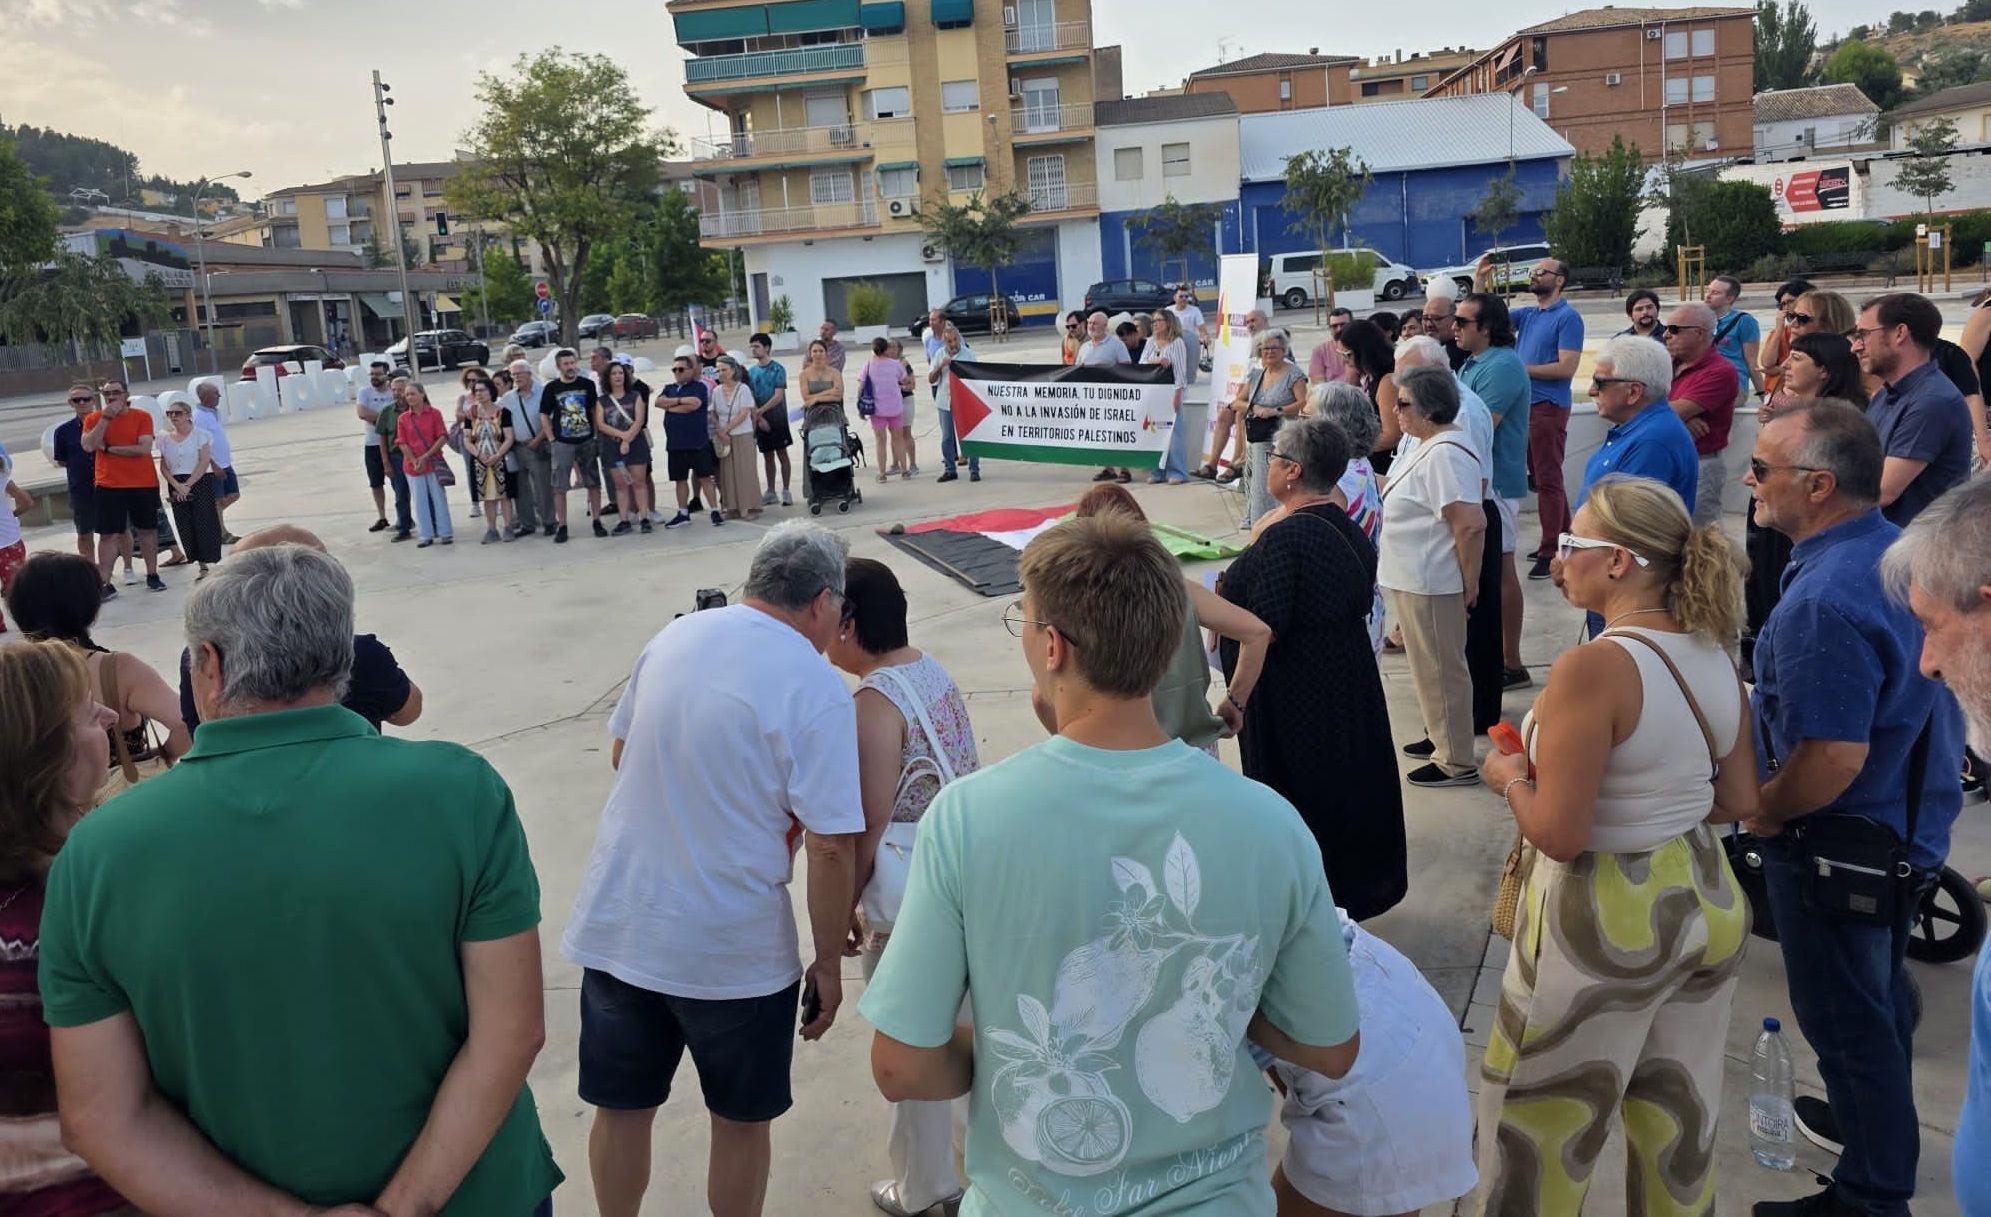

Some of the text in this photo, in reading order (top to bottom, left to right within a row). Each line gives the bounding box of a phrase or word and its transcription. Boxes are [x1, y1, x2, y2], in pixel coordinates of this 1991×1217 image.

[1195, 279, 1214, 287] CAR
[1027, 293, 1045, 302] CAR
[988, 385, 1141, 400] NUESTRA MEMORIA, TU DIGNIDAD
[1001, 404, 1136, 422] NO A LA INVASIÓN DE ISRAEL
[1001, 425, 1137, 444] EN TERRITORIOS PALESTINOS
[1166, 1131, 1259, 1188] Nient
